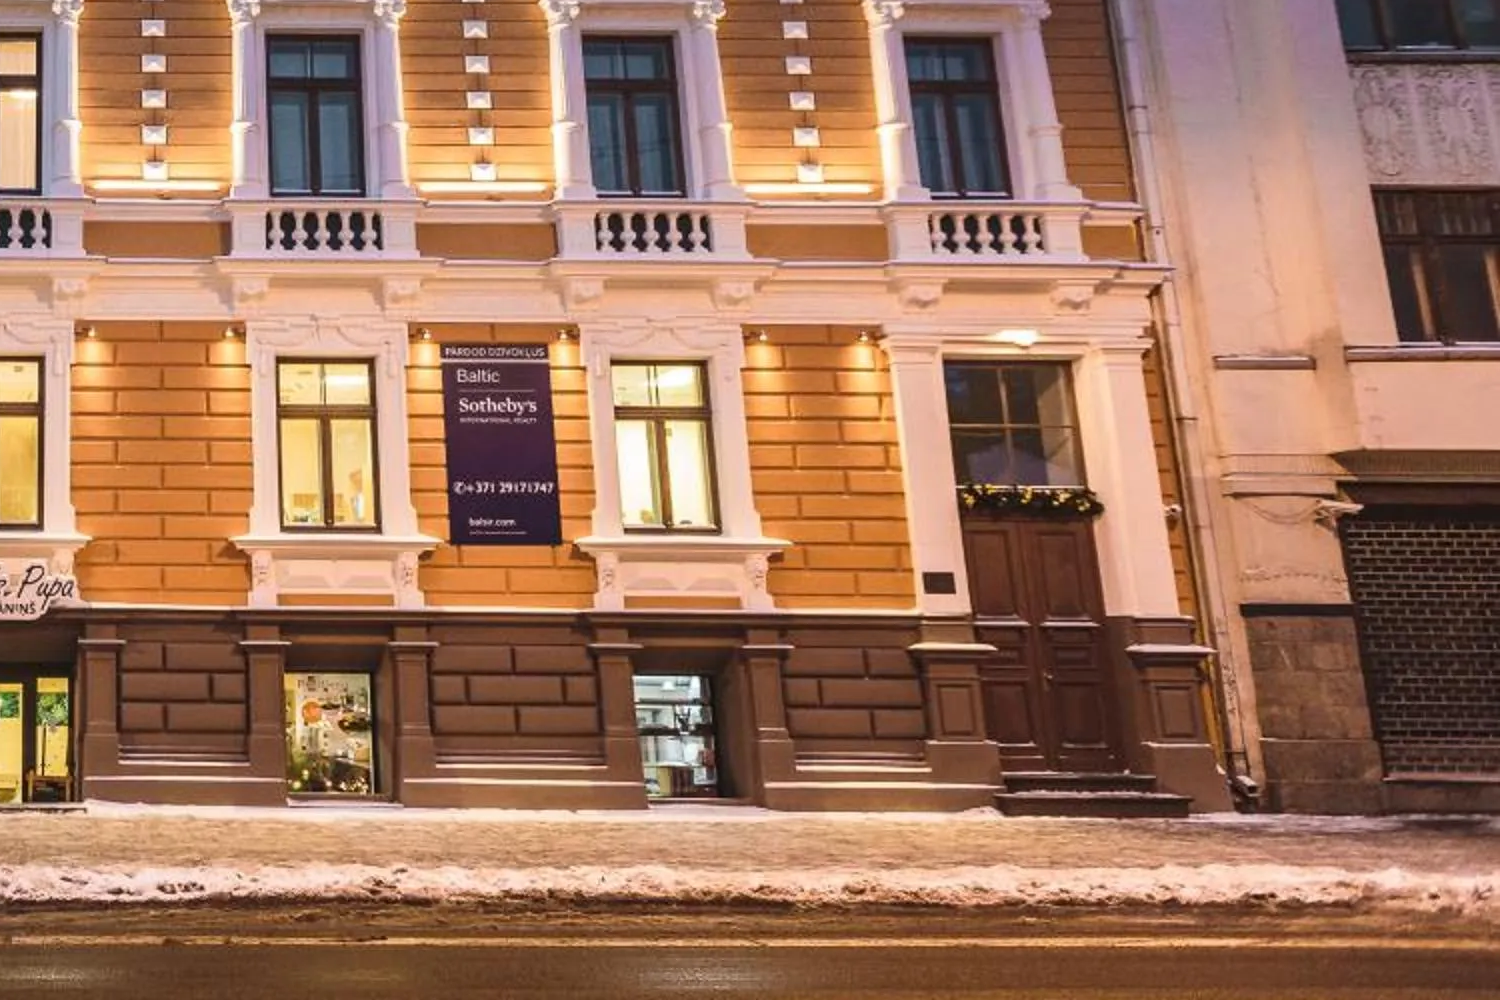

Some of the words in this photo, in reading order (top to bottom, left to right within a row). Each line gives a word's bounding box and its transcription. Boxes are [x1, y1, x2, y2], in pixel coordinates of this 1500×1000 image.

[456, 368, 501, 383] Baltic
[459, 397, 538, 417] Sotheby's
[499, 481, 555, 494] 29171747
[17, 564, 75, 611] Pupa
